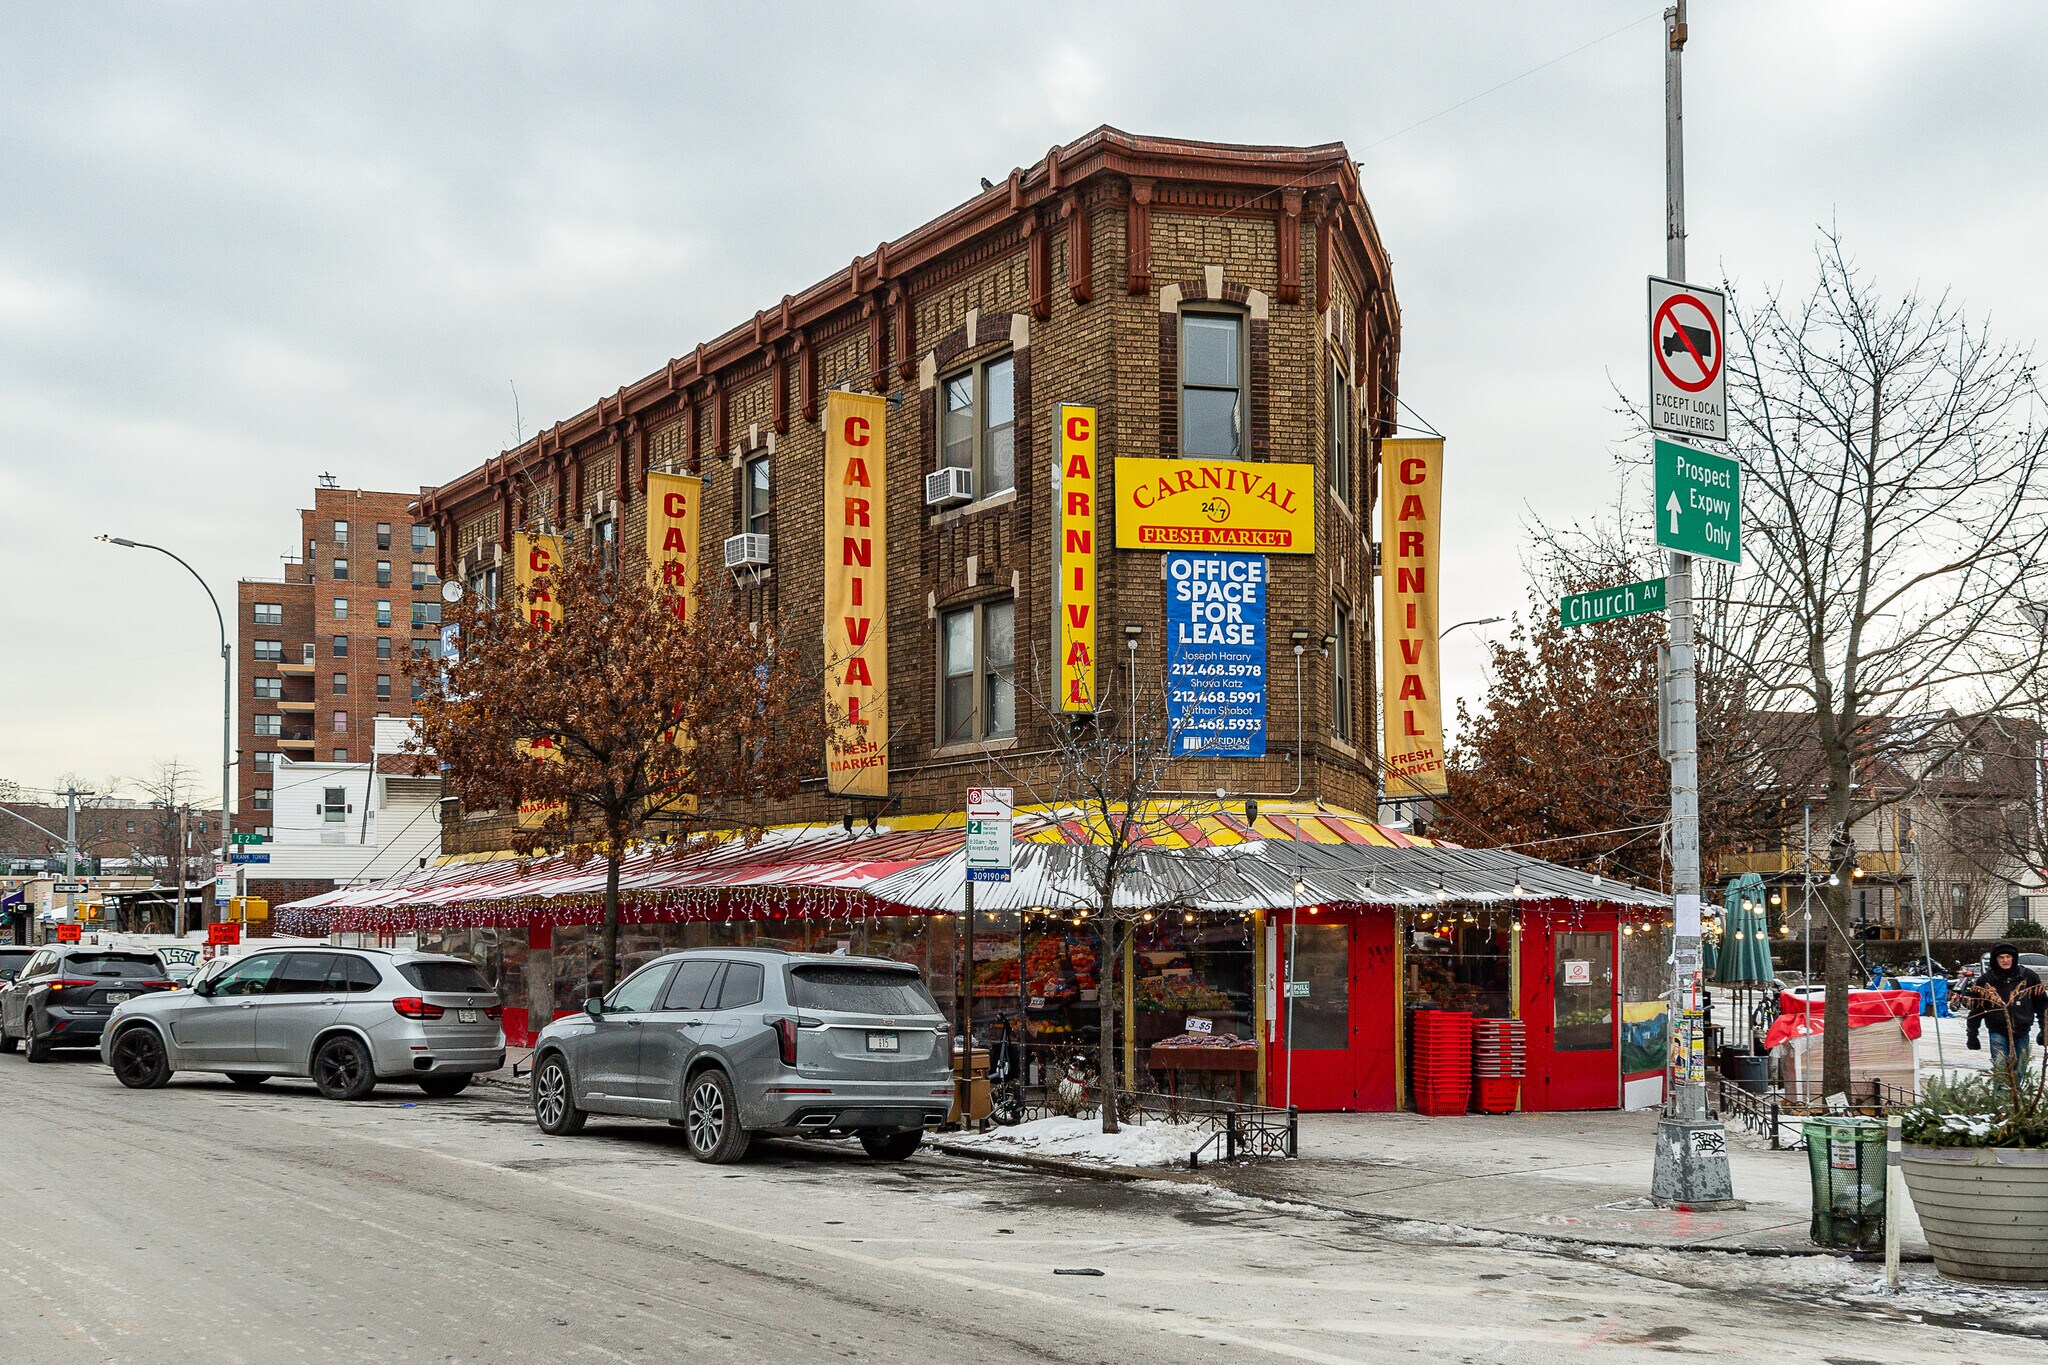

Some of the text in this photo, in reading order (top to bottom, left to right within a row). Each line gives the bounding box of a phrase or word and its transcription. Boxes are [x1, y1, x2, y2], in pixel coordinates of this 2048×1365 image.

[1656, 393, 1722, 416] EXCEPT LOCAL
[1664, 411, 1715, 432] DELIVERIES
[1677, 456, 1730, 489] Prospect
[1133, 467, 1297, 514] CARNIVAL
[1202, 502, 1226, 519] 24/7
[1690, 488, 1730, 520] Expwy
[1143, 528, 1288, 546] FRESH MARKET
[1706, 522, 1731, 550] Only
[1067, 418, 1090, 703] CARNIVAL
[1170, 559, 1262, 582] OFFICE
[845, 417, 872, 725] CARNIVAL
[1176, 580, 1256, 603] SPACE
[1398, 459, 1426, 735] CARNIVAL
[1192, 602, 1244, 623] FOR
[1570, 585, 1658, 621] Church Av
[1179, 623, 1254, 644] LEASE
[1182, 652, 1252, 662] Joseph Harary
[1172, 664, 1261, 676] 212.468.5978
[1222, 679, 1243, 688] Katz
[1172, 691, 1260, 704] 212.468.5991
[830, 755, 886, 772] MARKET
[1390, 748, 1434, 766] FRESH
[1387, 760, 1442, 780] MARKET
[520, 800, 565, 814] MARKET
[971, 822, 978, 833] 2
[238, 835, 242, 844] E
[245, 835, 250, 844] 2
[972, 872, 1000, 881] 309190
[1188, 1020, 1196, 1028] 3
[1199, 1022, 1213, 1031] $5
